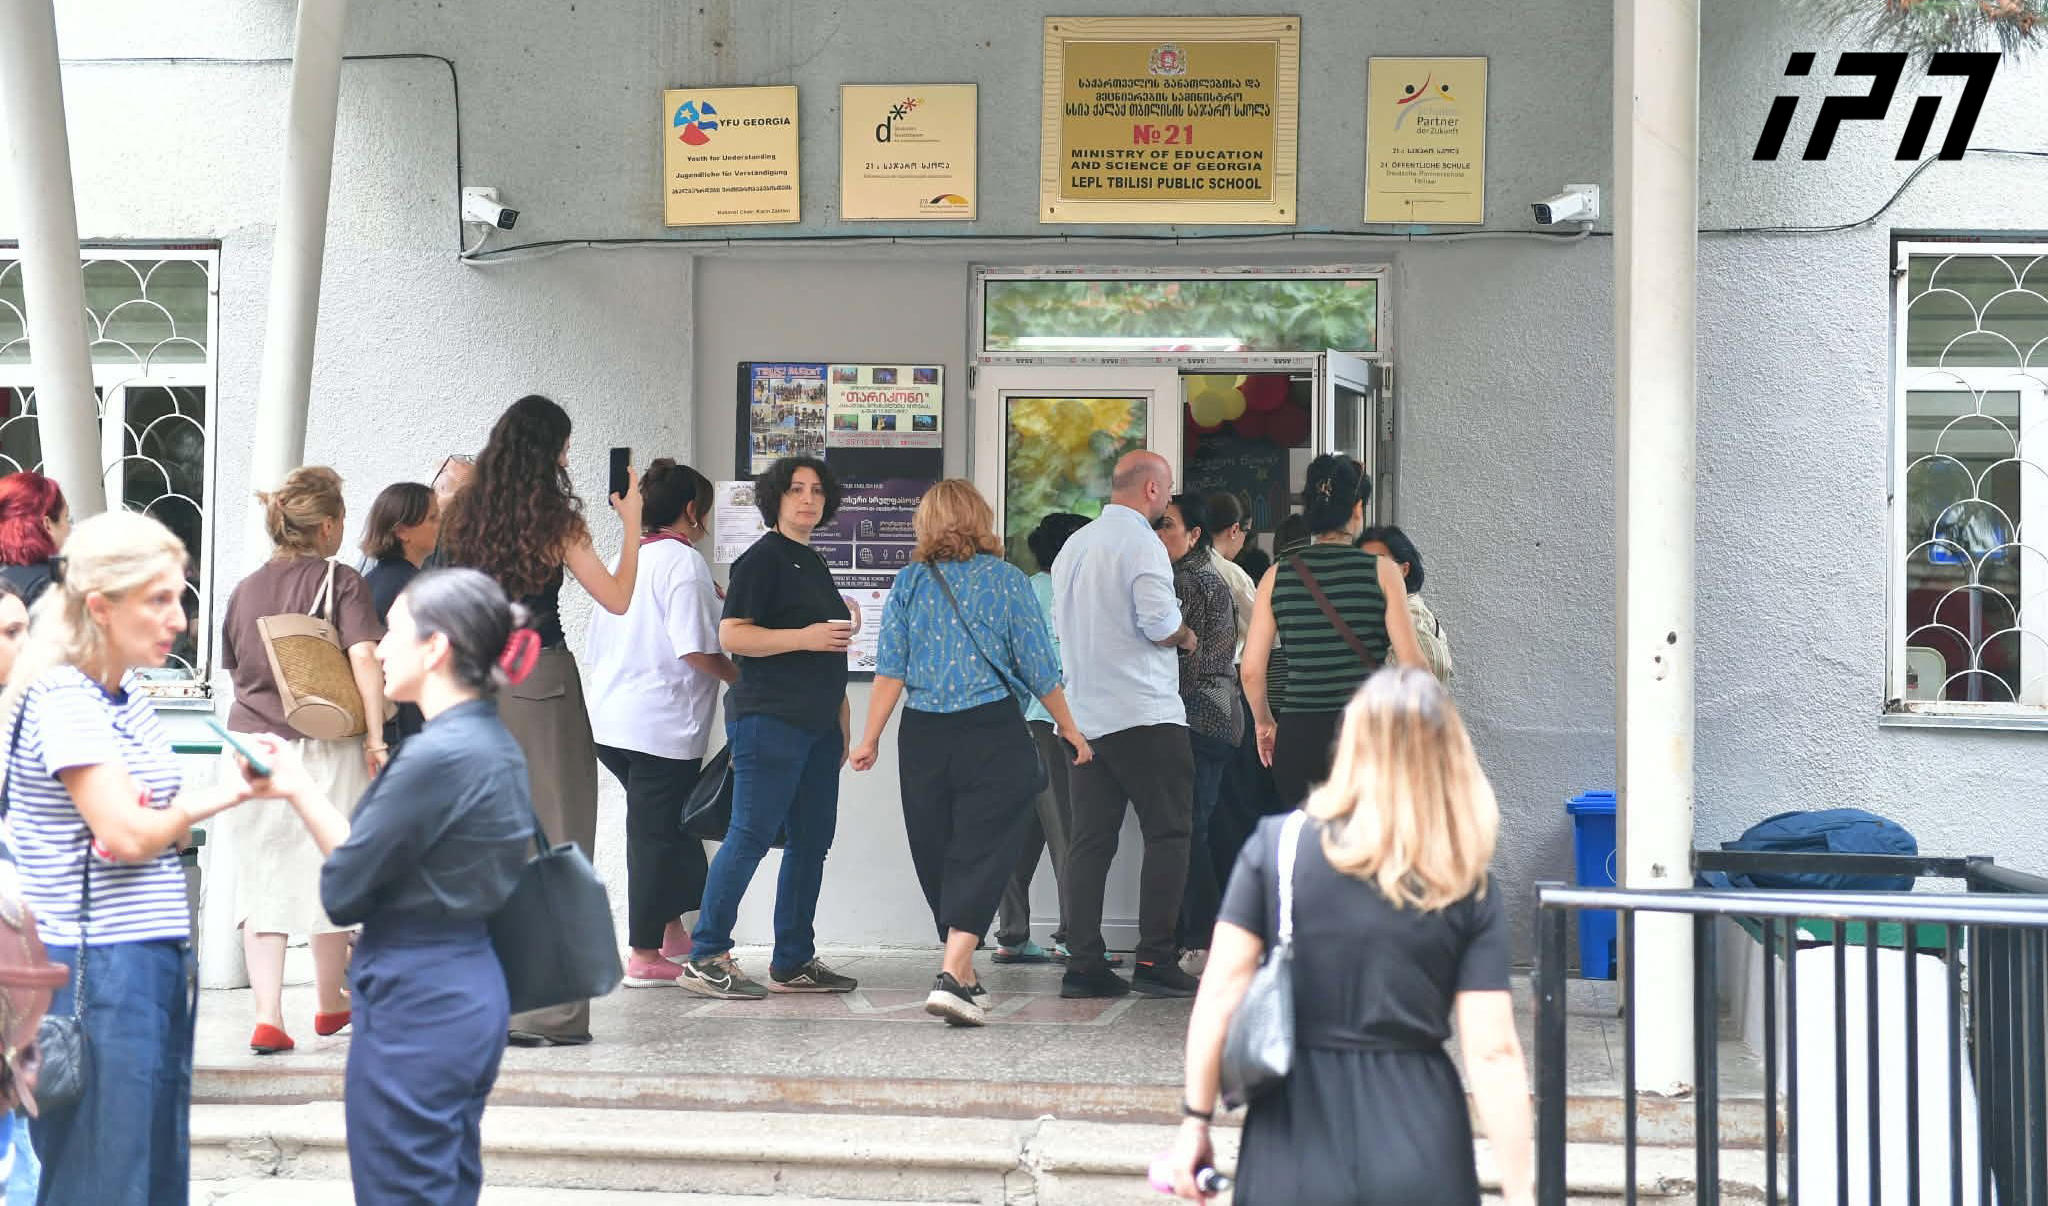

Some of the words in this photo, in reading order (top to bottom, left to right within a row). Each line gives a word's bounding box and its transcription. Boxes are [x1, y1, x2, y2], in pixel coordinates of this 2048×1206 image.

[1078, 78, 1160, 89] საქართველოს
[1163, 78, 1241, 89] განათლებისა
[1245, 79, 1261, 89] და
[1095, 92, 1168, 102] მეცნიერების
[1171, 92, 1243, 102] სამინისტრო
[1093, 103, 1127, 116] ქალაქ
[1129, 103, 1184, 117] თბილისის
[1187, 103, 1231, 117] საჯარო
[1233, 103, 1271, 117] სკოლა
[719, 118, 740, 127] YFU
[743, 117, 791, 127] GEORGIA
[1417, 116, 1460, 126] Partner
[1072, 149, 1145, 158] MINISTRY
[1150, 150, 1169, 159] OF
[1175, 150, 1264, 160] EDUCATION
[1071, 161, 1101, 170] AND
[1105, 161, 1169, 170] SCIENCE
[1173, 162, 1192, 171] OF
[1196, 162, 1262, 171] GEORGIA
[1391, 161, 1441, 169] ÖFFENTLICHE
[1442, 162, 1471, 170] SCHULE
[676, 172, 721, 180] Jugendliche
[1072, 176, 1103, 188] LEPL
[1106, 177, 1153, 189] TBILISI
[1157, 177, 1204, 189] PUBLIC
[1209, 178, 1263, 190] SCHOOL
